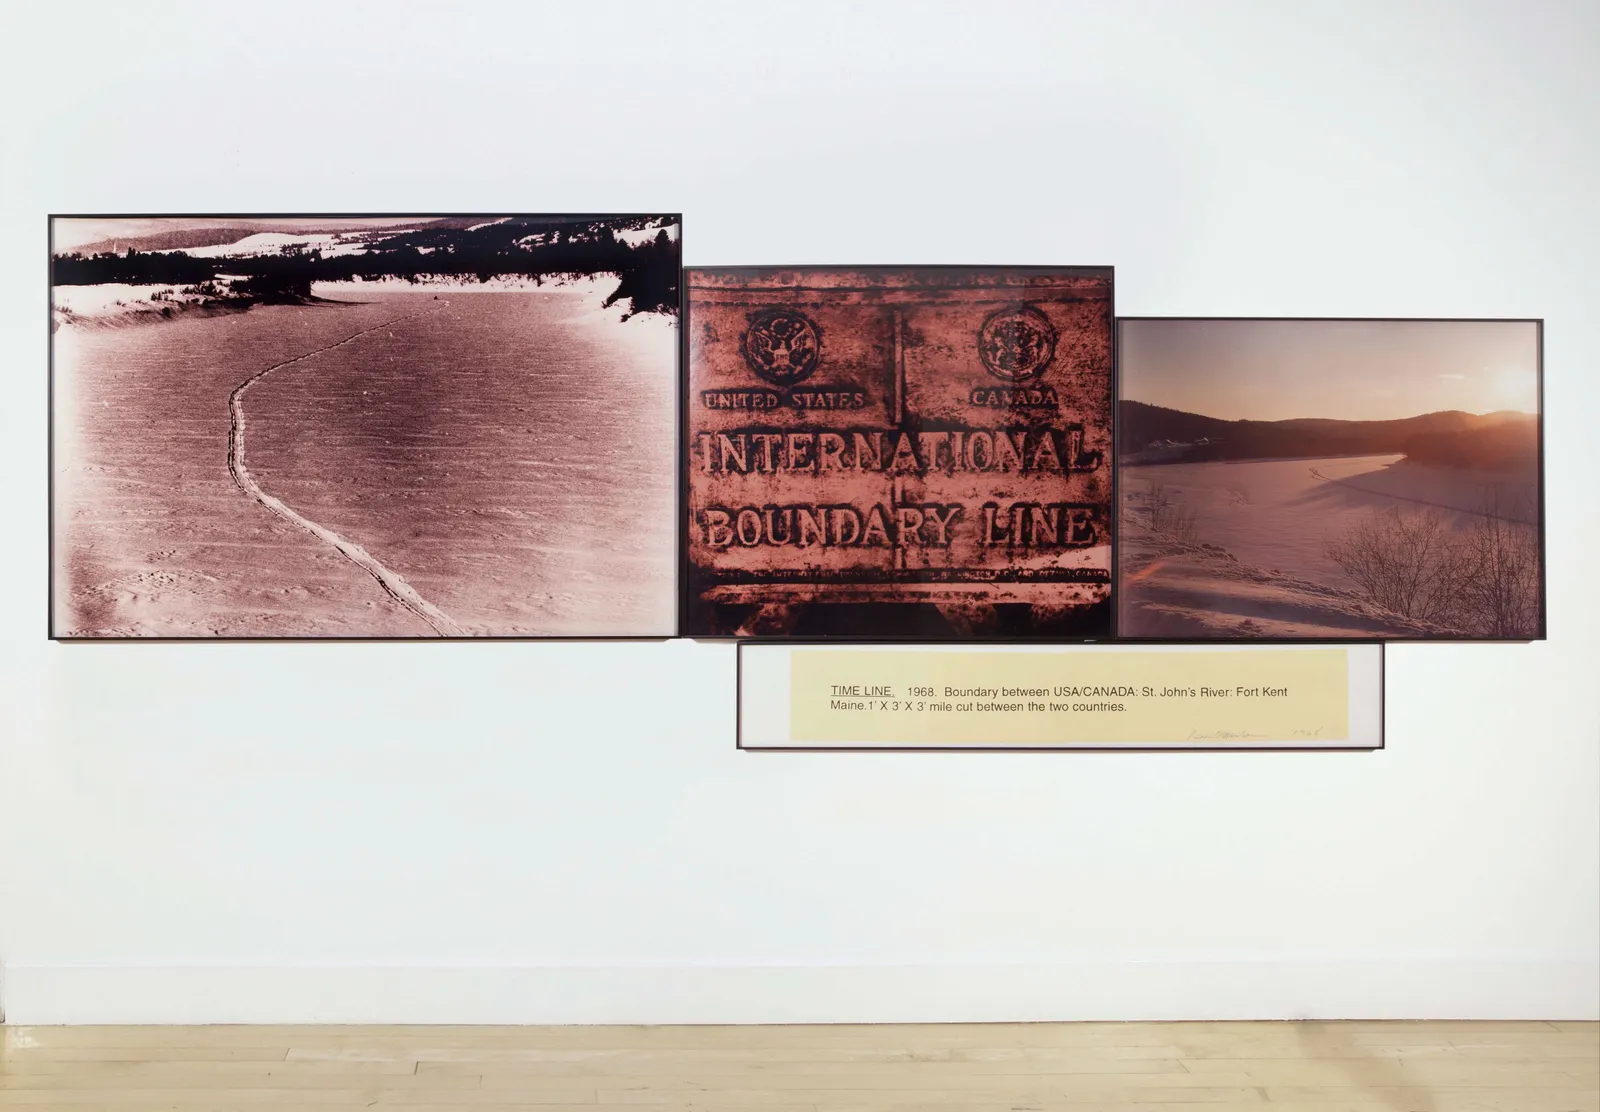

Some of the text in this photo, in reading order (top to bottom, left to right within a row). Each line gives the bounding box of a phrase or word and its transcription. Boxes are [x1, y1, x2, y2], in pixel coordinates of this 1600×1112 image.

[705, 392, 864, 408] UNITED STATES
[972, 390, 1058, 406] CANADA
[700, 430, 1098, 473] INTERNATIONAL
[706, 506, 1096, 547] BOUNDARY LINE
[831, 685, 1288, 700] TIME LINE. 1968. Boundary between USA/CANADA: St. John's River: Fort Kent
[880, 701, 888, 711] X
[892, 701, 902, 711] 3'
[904, 702, 913, 711] X
[916, 702, 927, 711] 3'
[929, 701, 953, 712] mile
[955, 702, 974, 712] cut
[976, 702, 1024, 712] between
[1027, 702, 1046, 712] the
[1049, 703, 1069, 712] two
[1072, 702, 1127, 712] countries.
